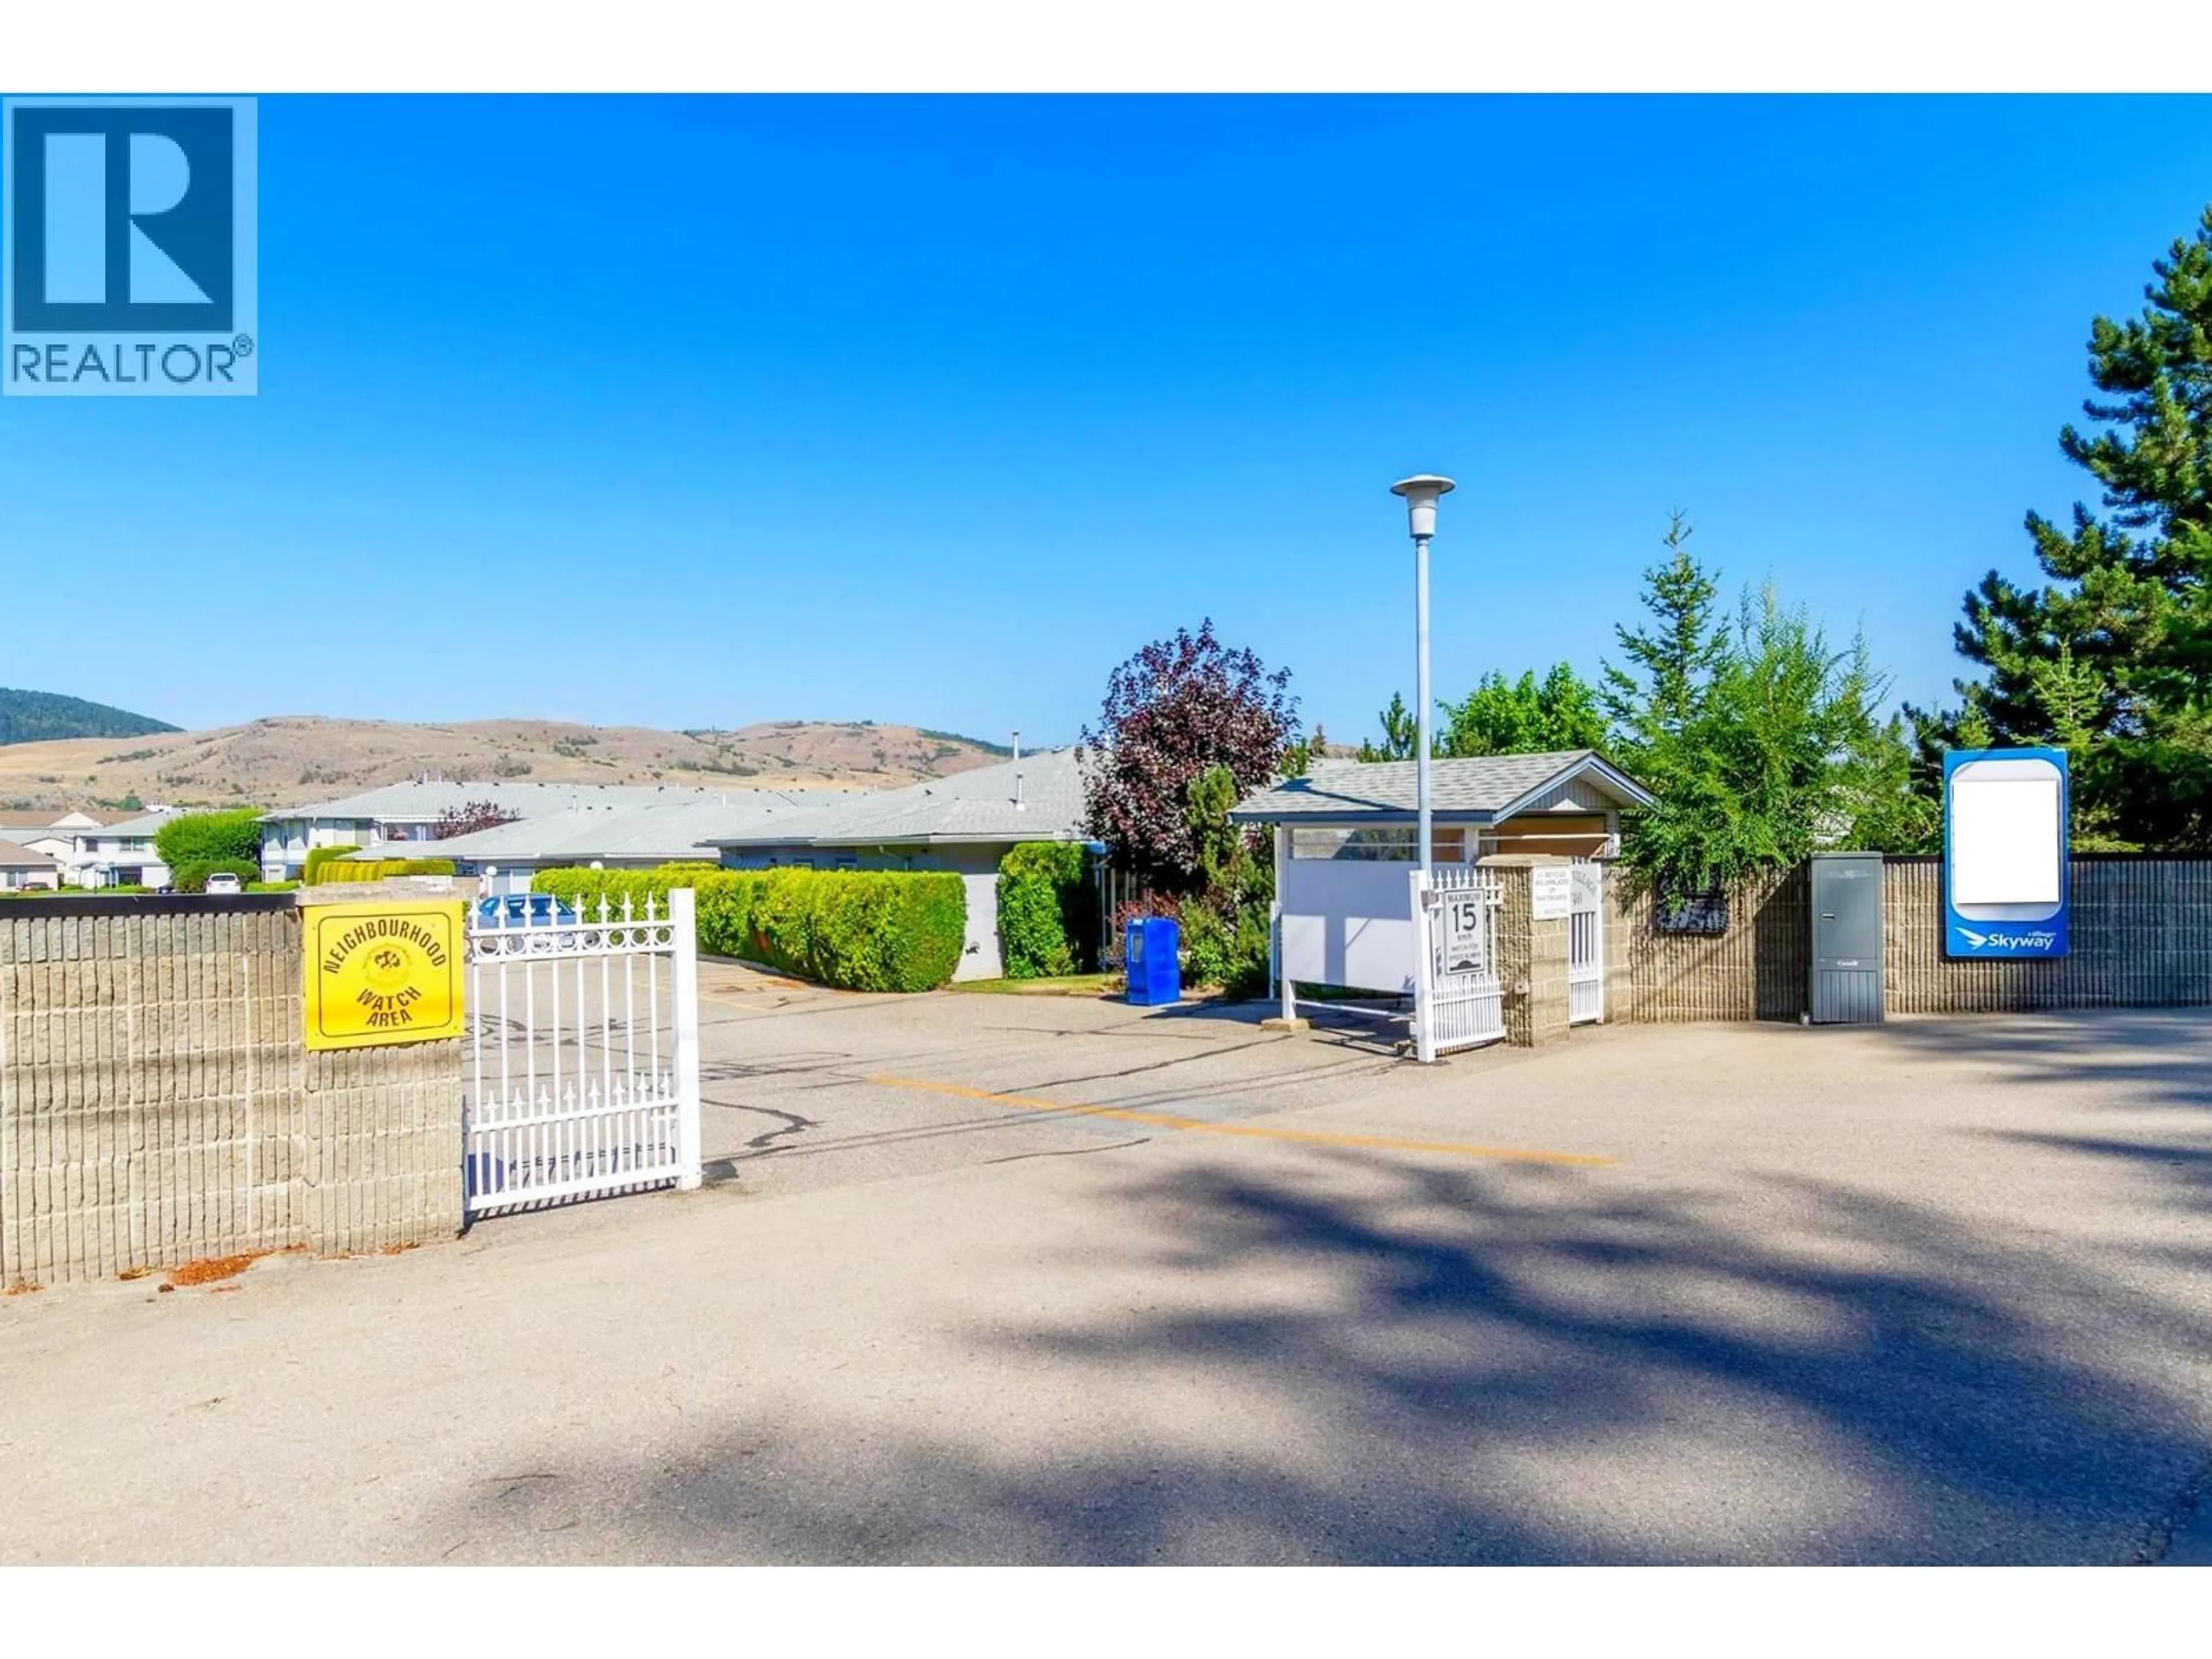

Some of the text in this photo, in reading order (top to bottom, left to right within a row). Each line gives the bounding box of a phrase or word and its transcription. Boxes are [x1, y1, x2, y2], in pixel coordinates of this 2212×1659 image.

[1452, 903, 1476, 933] 15
[323, 919, 446, 974] NEIGHBOURHOOD
[1988, 933, 2054, 951] Skyway
[357, 986, 422, 1010] WATCH
[365, 1009, 412, 1027] AREA
